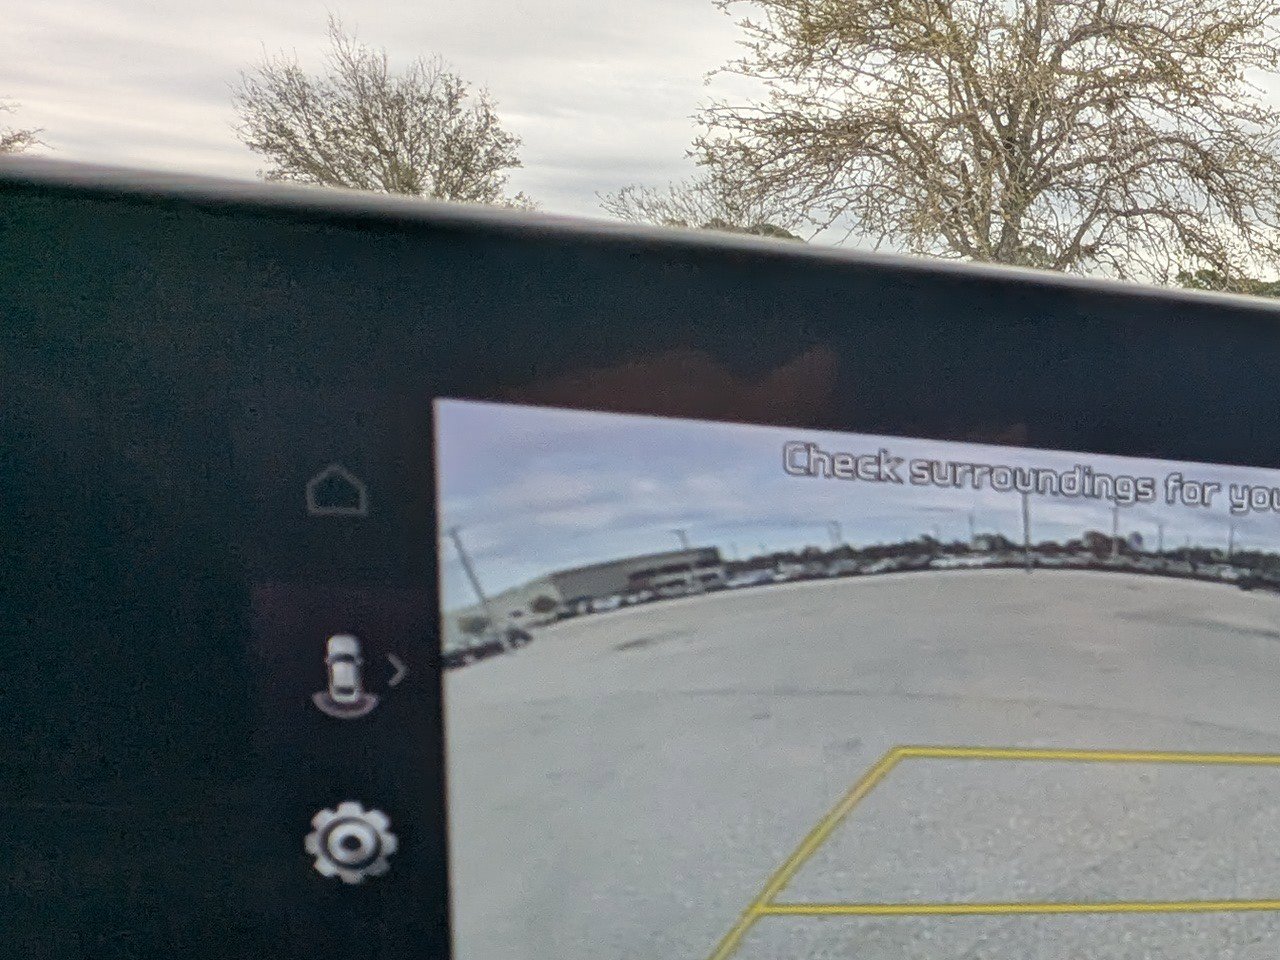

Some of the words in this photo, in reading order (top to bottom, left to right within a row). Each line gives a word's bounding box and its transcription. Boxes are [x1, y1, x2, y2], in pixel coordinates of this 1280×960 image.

[783, 440, 904, 484] Check
[909, 457, 1154, 507] surroundings
[1164, 471, 1220, 505] for
